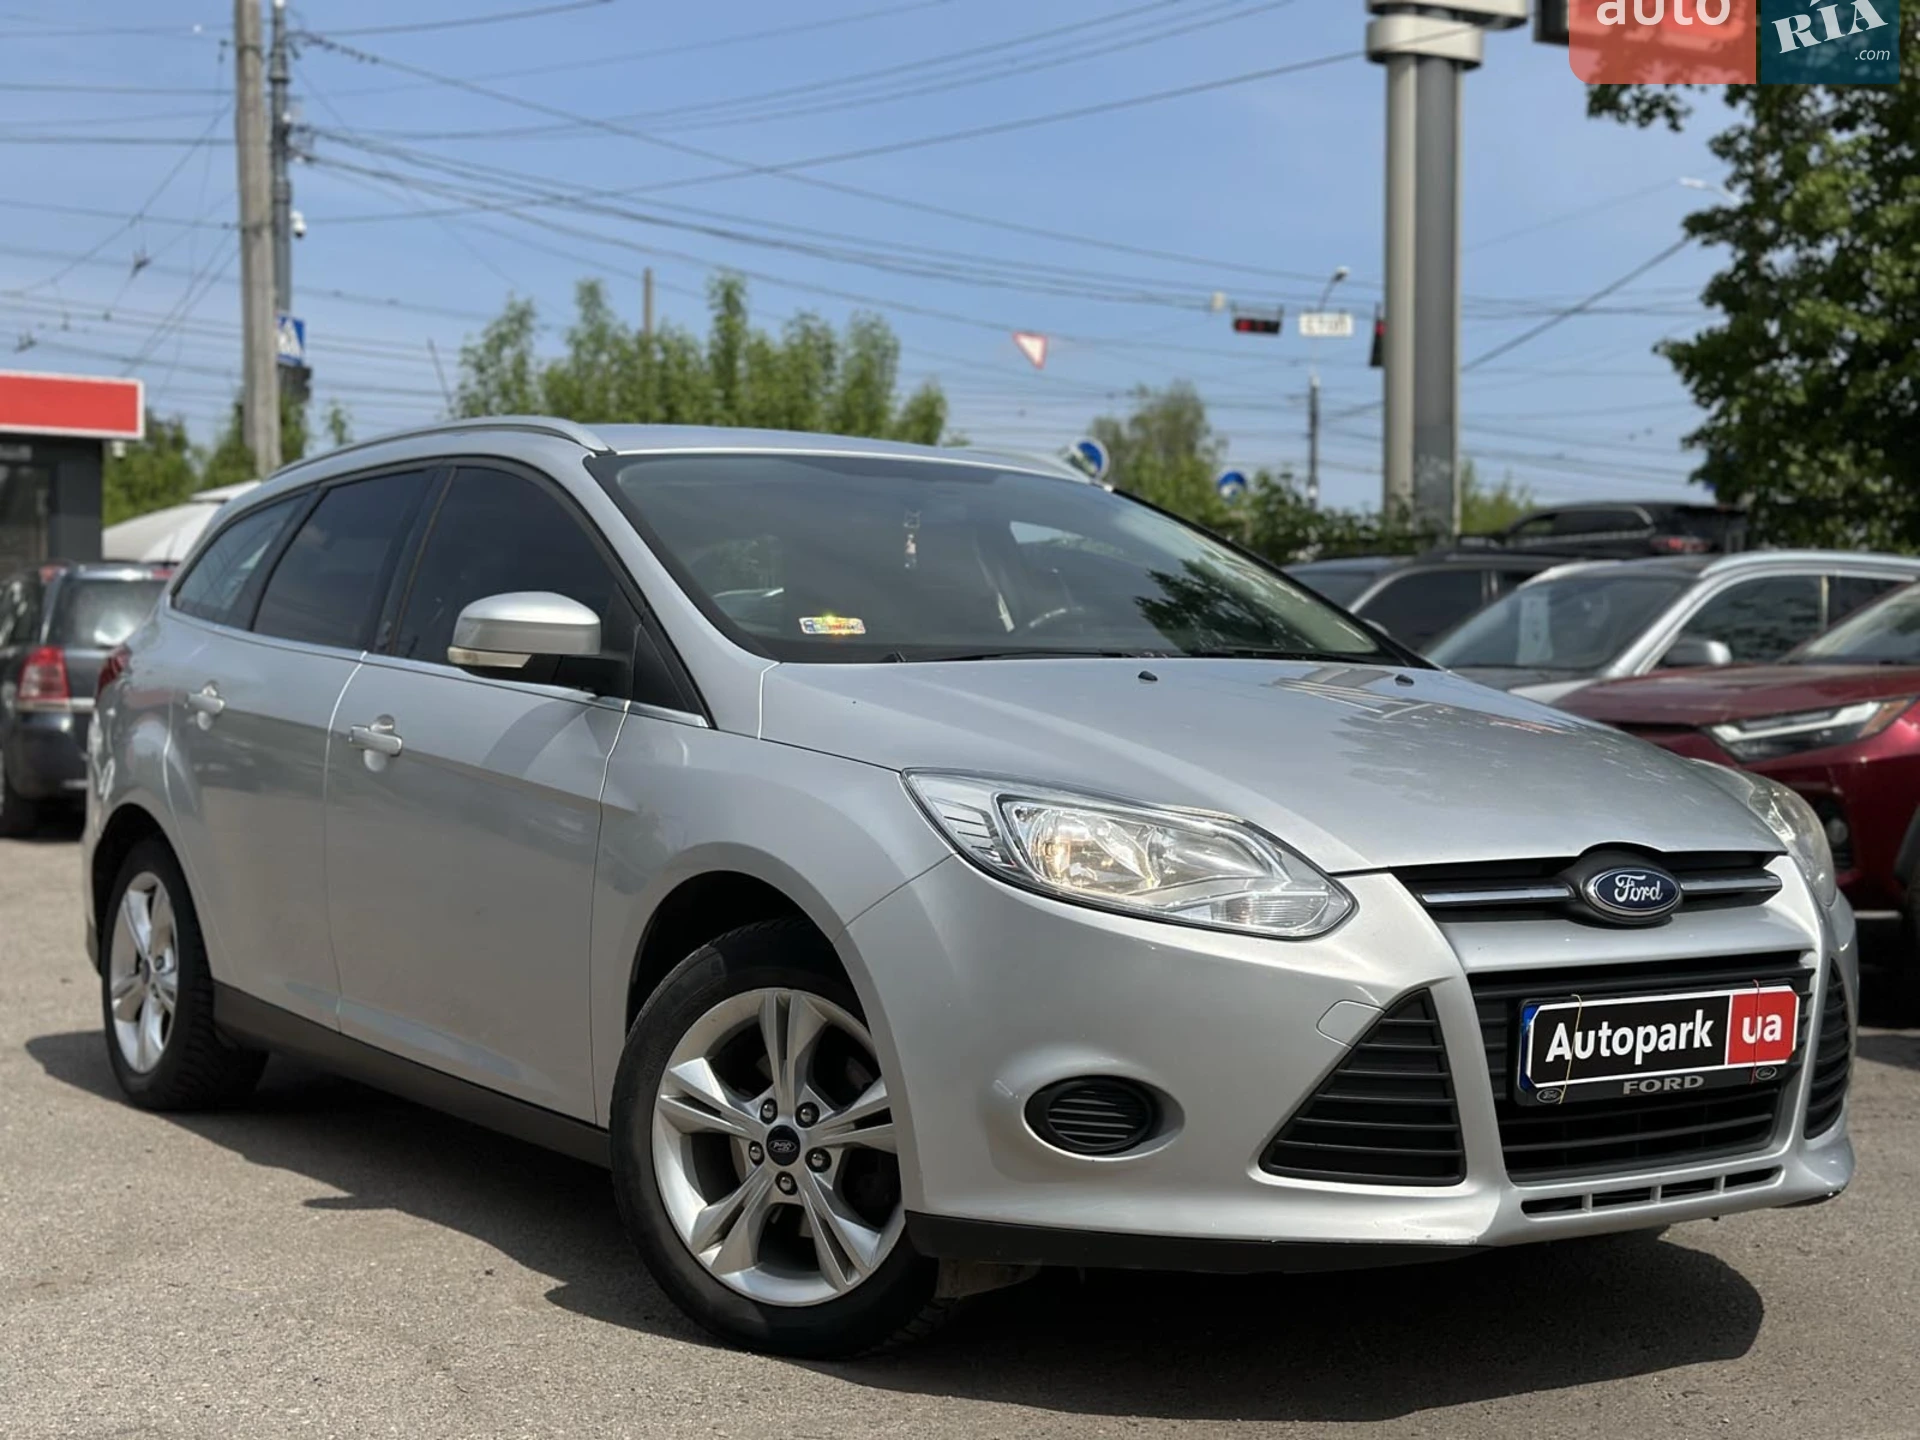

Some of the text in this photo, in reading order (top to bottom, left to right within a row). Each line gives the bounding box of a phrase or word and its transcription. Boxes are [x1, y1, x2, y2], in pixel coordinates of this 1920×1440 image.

[1614, 874, 1663, 903] Ford
[1545, 1008, 1783, 1066] Autopark ua
[1622, 1074, 1705, 1095] FORD
